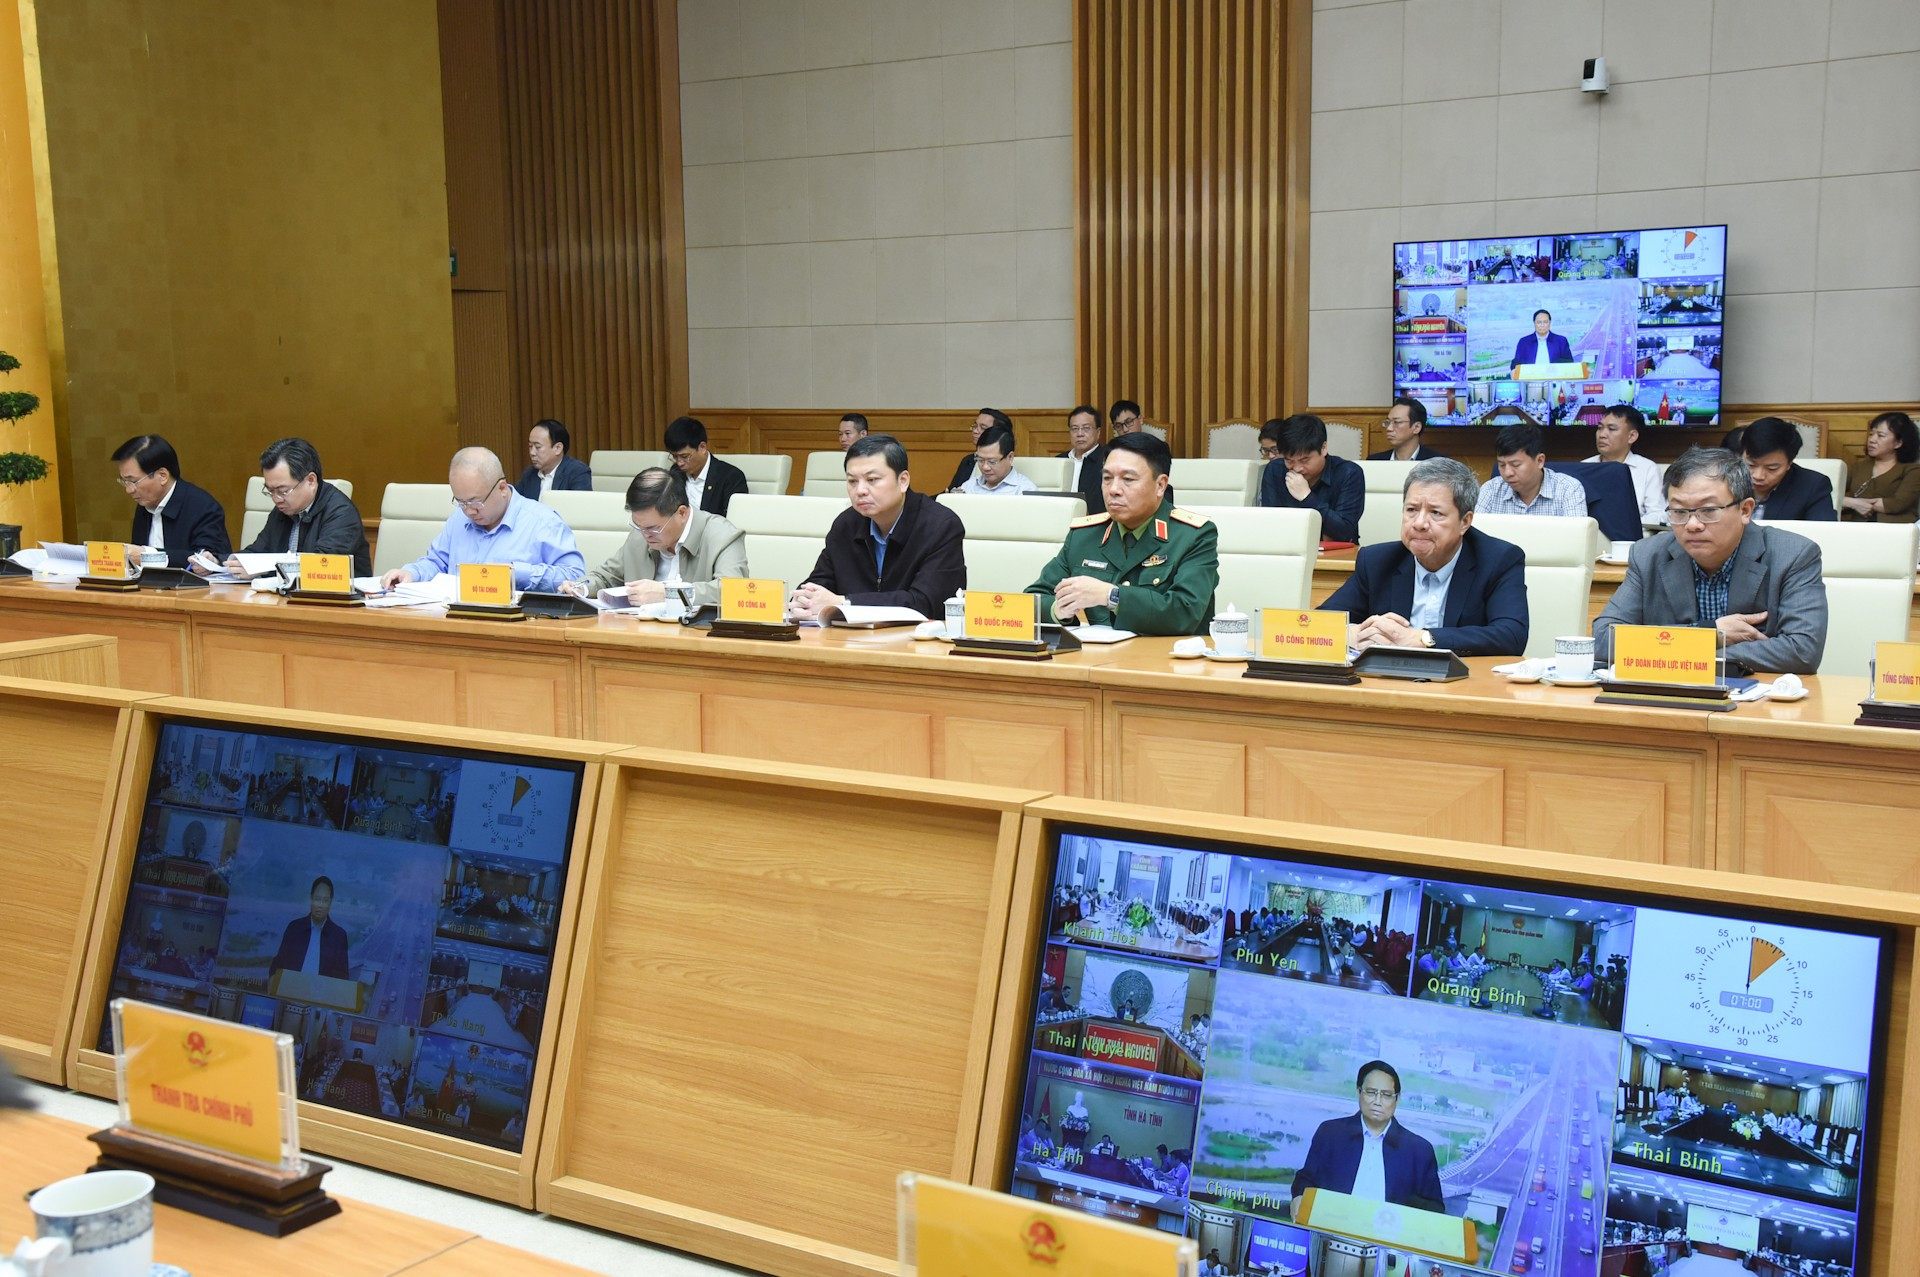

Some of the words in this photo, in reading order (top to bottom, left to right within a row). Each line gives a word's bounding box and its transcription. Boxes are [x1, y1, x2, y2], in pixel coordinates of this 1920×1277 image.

[738, 600, 744, 608] BỘ
[746, 600, 758, 608] CÔNG
[974, 617, 982, 626] BỘ
[984, 617, 1000, 627] QUỐC
[1002, 619, 1023, 628] PHÒNG
[1276, 634, 1285, 645] BỘ
[1286, 634, 1304, 644] CÔNG
[1306, 636, 1333, 646] THƯƠNG
[1623, 656, 1634, 669] TẬP
[1635, 657, 1651, 668] ĐOÀN
[1653, 658, 1667, 670] ĐIỆN
[1668, 660, 1678, 671] LỰC
[1680, 660, 1692, 672] VIỆT
[1694, 662, 1708, 671] NAM
[1883, 671, 1897, 684] TỔNG
[1898, 673, 1914, 685] CÔNG
[1064, 922, 1105, 940] Khanh
[1111, 926, 1136, 945] Hoa
[1718, 929, 1729, 937] 55
[1695, 946, 1706, 954] 50
[1236, 948, 1263, 965] Phu
[1271, 953, 1298, 970] Yen
[1797, 961, 1808, 969] 10
[1428, 978, 1480, 1004] Quang
[1489, 986, 1526, 1006] Binh
[1803, 990, 1813, 999] 15
[1730, 995, 1762, 1009] 07:00
[1791, 1017, 1802, 1026] 20
[1709, 1025, 1720, 1034] 35
[1049, 1030, 1077, 1048] Thai
[1737, 1038, 1748, 1046] 30
[1767, 1035, 1779, 1044] 25
[151, 1083, 181, 1108] THANH
[1032, 1142, 1049, 1157] Ha
[1633, 1141, 1670, 1164] Thai
[1680, 1150, 1722, 1175] Binh
[1206, 1181, 1246, 1202] Chinh
[1252, 1193, 1280, 1210] phu
